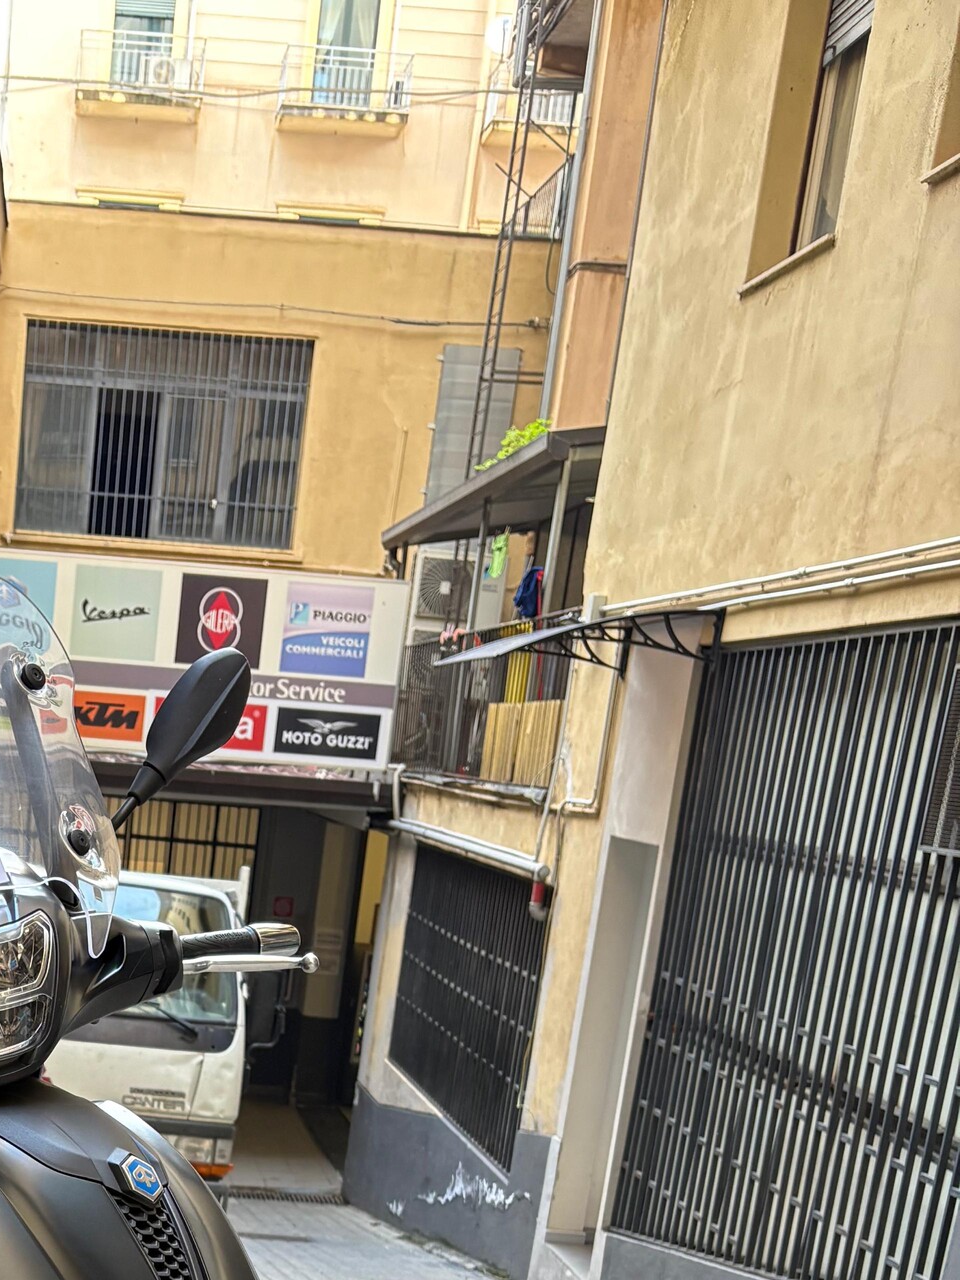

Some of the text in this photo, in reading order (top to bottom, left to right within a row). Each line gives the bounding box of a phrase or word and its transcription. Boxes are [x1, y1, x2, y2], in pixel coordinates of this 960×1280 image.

[81, 598, 150, 623] Vespa
[201, 608, 237, 634] GILERA
[313, 610, 367, 624] PIAGGIO
[285, 644, 363, 659] COMMERCIALI
[321, 636, 365, 648] VEICOLI
[275, 678, 346, 703] Service
[73, 701, 140, 730] KTM
[282, 729, 371, 750] MOTO GUZZI
